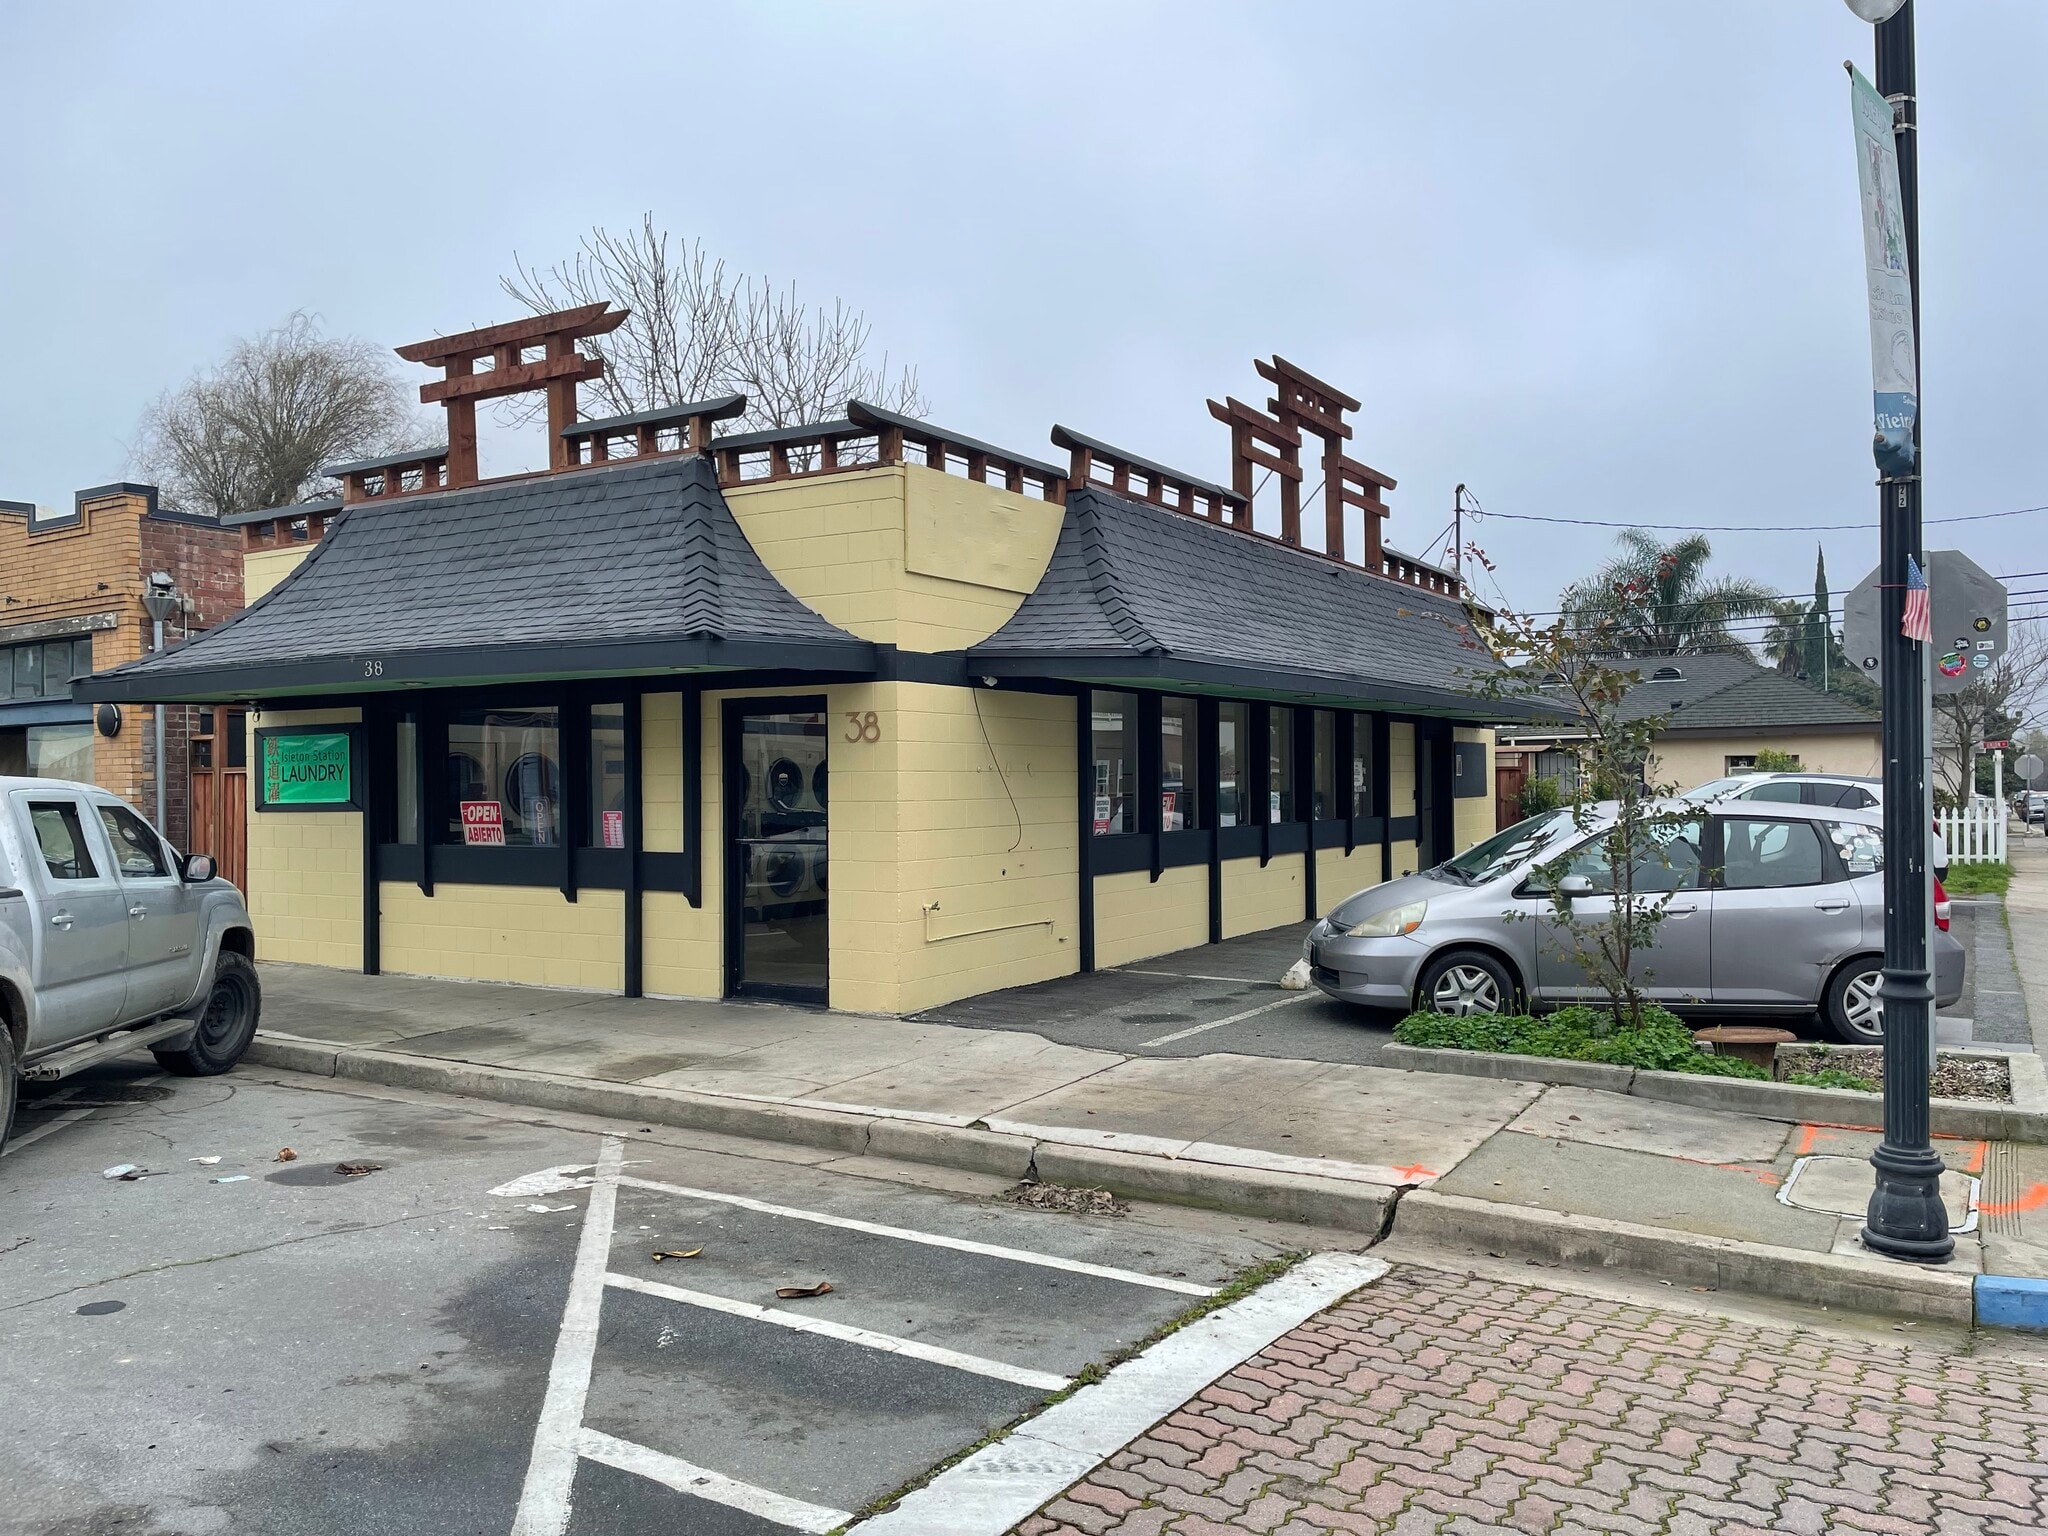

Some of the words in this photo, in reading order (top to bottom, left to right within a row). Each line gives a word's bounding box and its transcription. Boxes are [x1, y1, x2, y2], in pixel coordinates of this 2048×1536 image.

[364, 660, 383, 677] 38
[845, 711, 881, 743] 38
[281, 751, 310, 762] Isleton
[312, 749, 346, 762] Station
[281, 764, 346, 783] LAUNDRY
[535, 802, 546, 844] OPEN
[468, 827, 502, 843] ABIERTO
